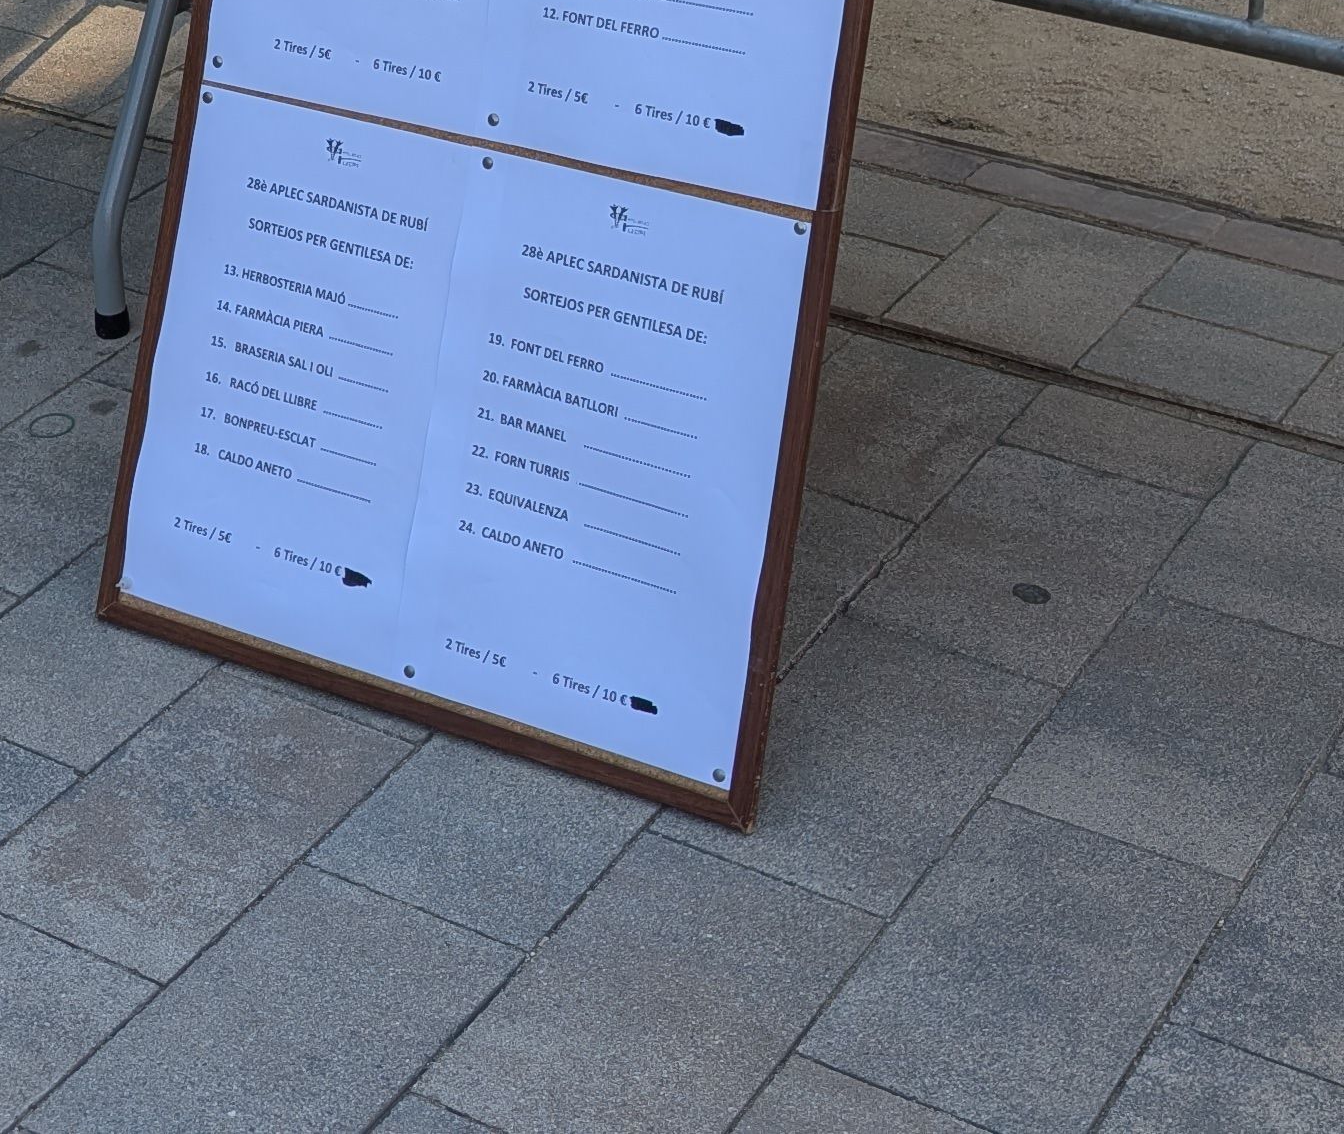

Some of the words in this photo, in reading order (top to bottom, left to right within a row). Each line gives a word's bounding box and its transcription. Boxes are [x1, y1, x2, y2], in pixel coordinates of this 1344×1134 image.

[543, 6, 559, 21] 12.
[563, 10, 594, 27] FONT
[596, 16, 617, 32] DEL
[621, 21, 659, 39] FERRO
[247, 176, 267, 193] 28è
[269, 182, 304, 202] APLEC
[306, 191, 379, 221] SARDANISTA
[382, 209, 398, 225] DE
[400, 213, 429, 232] RUBÍ
[249, 217, 303, 242] SORTEJOS
[306, 231, 327, 249] PER
[330, 238, 391, 265] GENTILESA
[395, 254, 414, 270] DE:
[224, 263, 239, 278] 13.
[242, 267, 312, 297] HERBOSTERIA
[315, 287, 346, 305] MAJÓ
[522, 244, 544, 261] 28è
[546, 250, 584, 271] APLEC
[587, 260, 668, 292] SARDANISTA
[671, 280, 689, 297] DE
[692, 285, 725, 305] RUBÍ
[217, 299, 231, 314] 14.
[235, 303, 290, 329] FARMÀCIA
[293, 319, 324, 338] PIERA
[524, 286, 584, 313] SORTEJOS
[587, 303, 610, 321] PER
[614, 310, 682, 339] GENTILESA
[686, 327, 707, 345] DE:
[211, 335, 226, 350] 15.
[235, 341, 285, 366] BRASERIA
[288, 355, 307, 371] SAL
[310, 361, 314, 373] I
[316, 363, 333, 378] OLI
[489, 332, 504, 347] 19.
[511, 338, 542, 357] FONT
[544, 346, 563, 364] DEL
[567, 353, 604, 374] FERRO
[206, 370, 221, 385] 16.
[230, 376, 259, 395] RACÓ
[262, 385, 280, 402] DEL
[283, 391, 318, 412] LLIBRE
[483, 369, 499, 385] 20.
[503, 374, 562, 403] FARMÀCIA
[565, 392, 619, 418] BATLLORI
[200, 406, 216, 421] 17.
[224, 412, 316, 448] BONPREU-ESCLAT
[477, 406, 494, 422] 21.
[500, 413, 523, 431] BAR
[526, 420, 567, 443] MANEL
[195, 442, 209, 456] 18.
[218, 449, 254, 468] CALDO
[255, 459, 292, 480] ANETO
[472, 444, 488, 460] 22.
[495, 450, 526, 470] FORN
[530, 460, 570, 482] TURRIS
[466, 481, 482, 497] 23.
[489, 488, 569, 522] EQUIVALENZA
[459, 519, 475, 535] 24.
[482, 526, 521, 547] CALDO
[523, 538, 564, 560] ANETO
